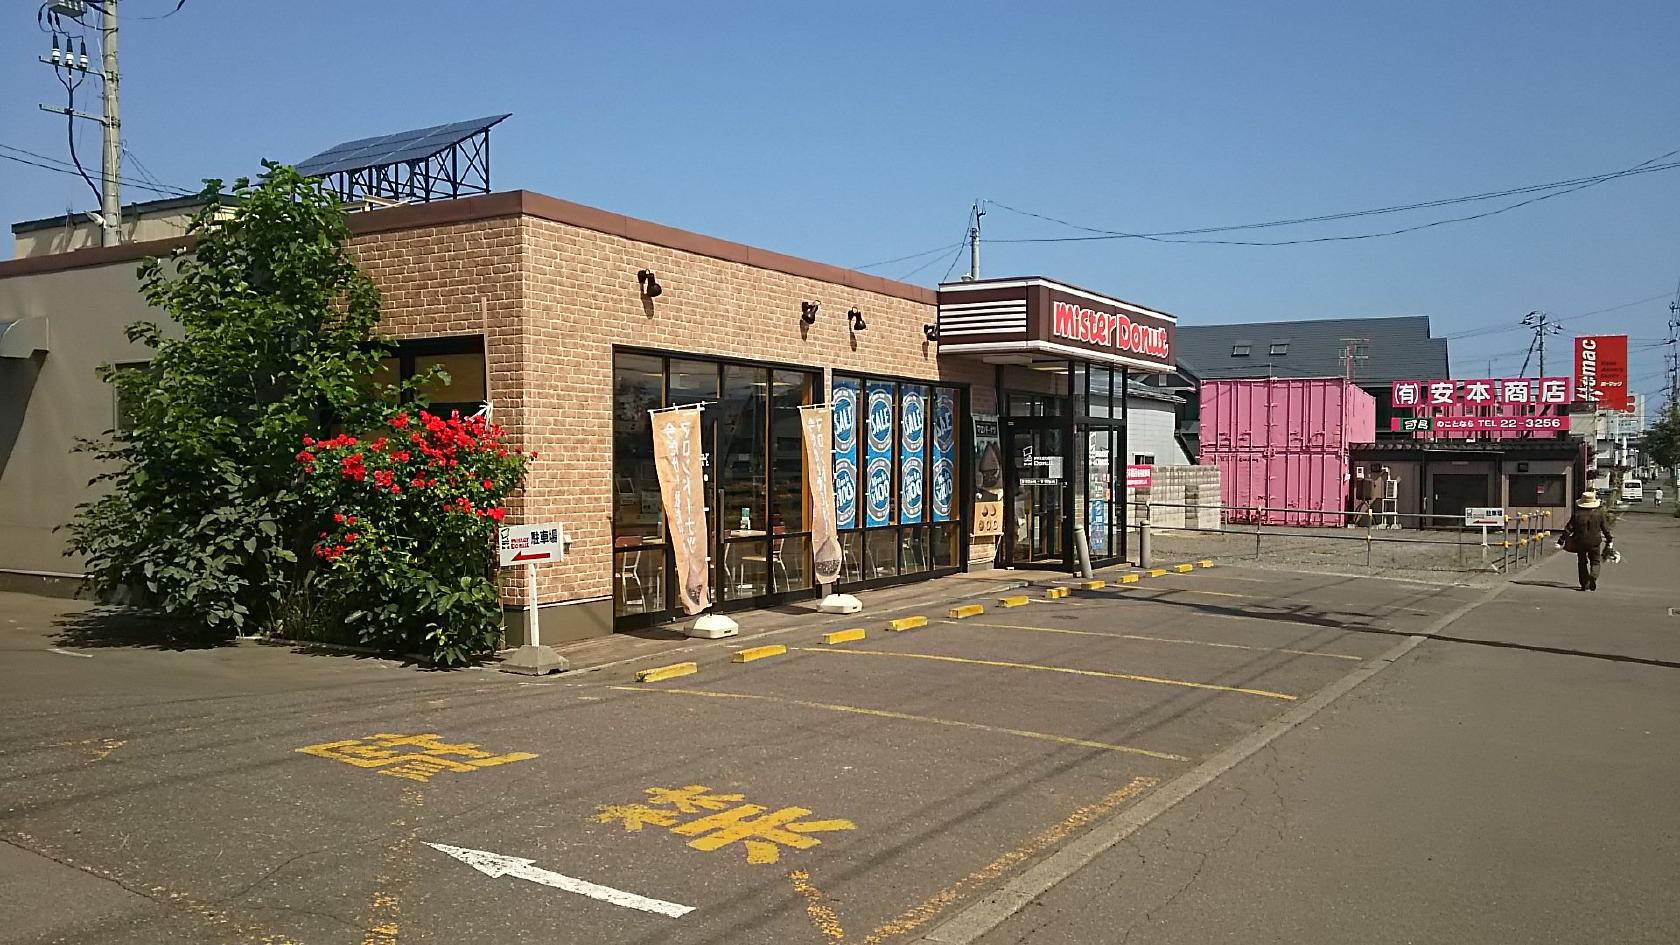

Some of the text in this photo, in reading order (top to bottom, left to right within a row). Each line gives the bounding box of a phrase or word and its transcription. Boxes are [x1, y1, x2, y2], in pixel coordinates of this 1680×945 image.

[1116, 314, 1169, 358] Donut
[871, 407, 890, 435] SALE
[1477, 419, 1498, 428] TEL
[1500, 418, 1561, 429] 22-3256
[530, 528, 558, 545] 駐車場
